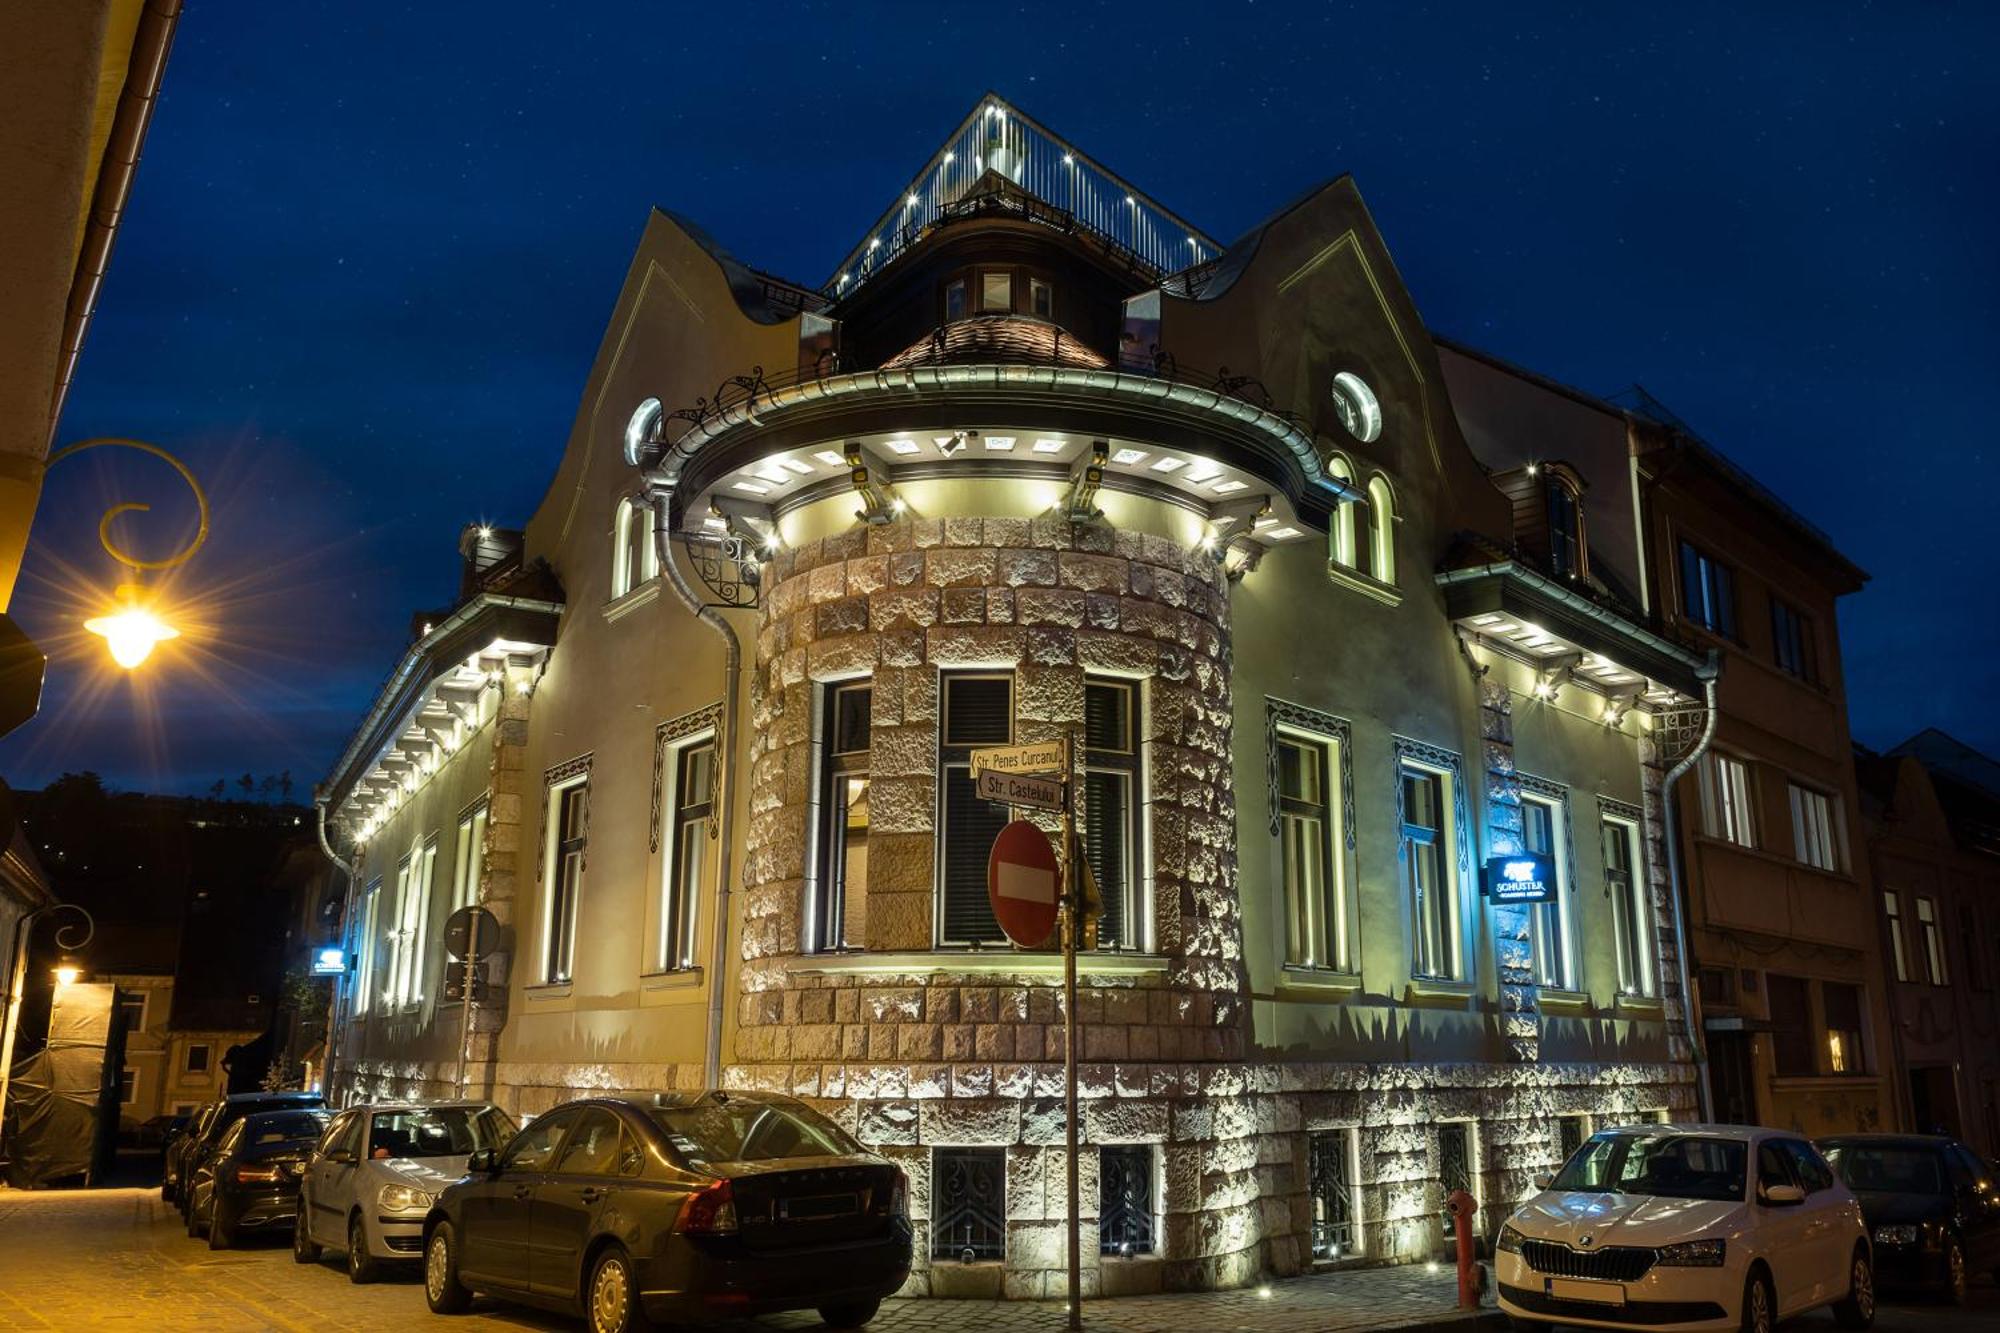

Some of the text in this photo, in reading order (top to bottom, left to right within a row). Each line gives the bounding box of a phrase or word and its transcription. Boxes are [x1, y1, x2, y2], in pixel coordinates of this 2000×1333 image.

[977, 756, 991, 769] Str.
[994, 753, 1018, 769] Penes
[988, 777, 1055, 803] Str. Castelului
[1496, 881, 1546, 893] SCHUSTER
